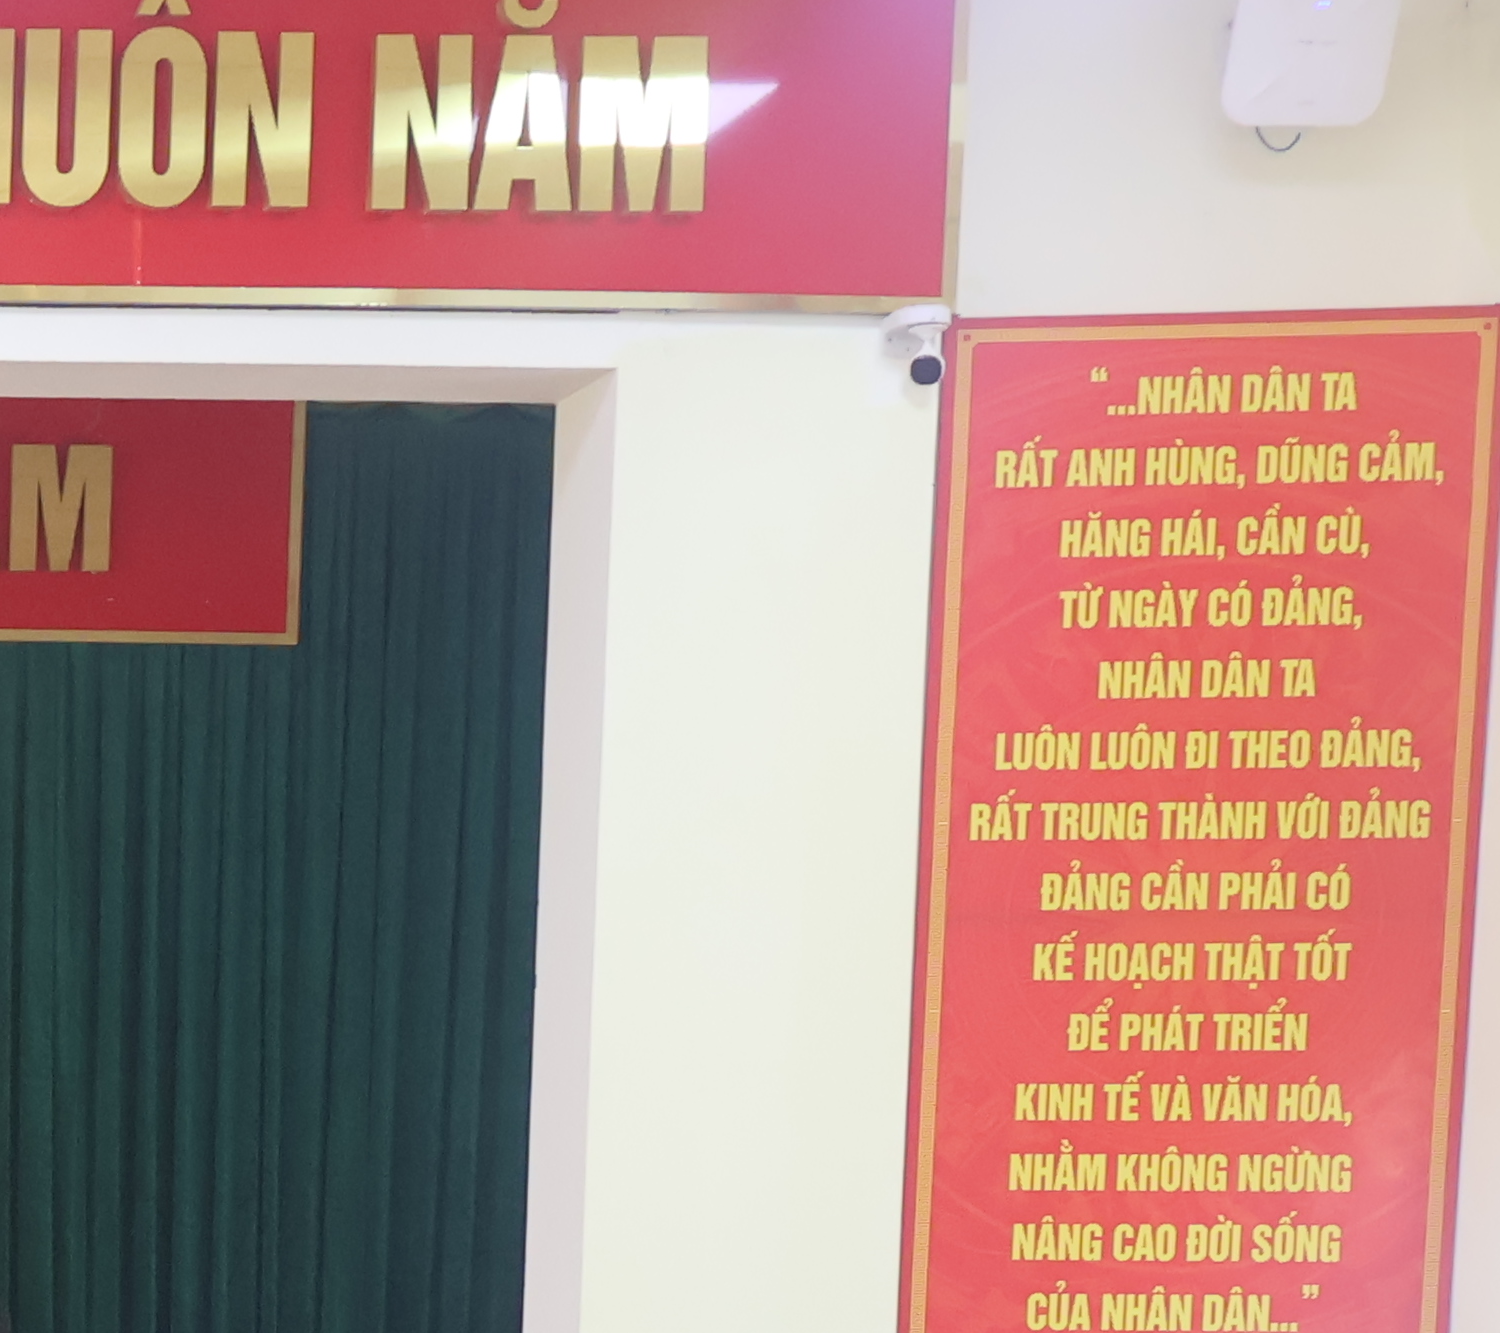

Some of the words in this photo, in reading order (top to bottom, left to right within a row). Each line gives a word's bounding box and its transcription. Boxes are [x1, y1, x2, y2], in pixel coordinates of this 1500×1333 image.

[369, 0, 710, 213] NĂM
[1241, 366, 1310, 412] DÂN
[1321, 372, 1356, 411] TA
[996, 436, 1058, 488] RẤT
[1066, 449, 1135, 486] ANH
[1145, 439, 1245, 488] HÙNG,
[1257, 437, 1348, 484] DŨNG
[1359, 430, 1443, 485] CẢM,
[1060, 512, 1151, 557] HĂNG
[1161, 510, 1225, 560] HÁI,
[1109, 581, 1198, 628] NGÀY
[1208, 580, 1251, 626] CÓ
[1262, 575, 1362, 629] ĐẢNG,
[1098, 653, 1191, 699] NHÂN
[1201, 652, 1270, 698] DÂN
[1280, 659, 1315, 697] TA
[1033, 931, 1077, 980] KẾ
[1085, 943, 1194, 989] HOẠCH
[1205, 935, 1284, 989] THẬT
[1294, 929, 1352, 981] TỐT
[1067, 998, 1113, 1050] ĐỂ
[1120, 1005, 1204, 1051] PHÁT
[1213, 998, 1307, 1051] TRIỂN
[1117, 1146, 1227, 1191] KHÔNG
[1012, 1216, 1102, 1261] NÂNG
[1113, 1224, 1176, 1261] CAO
[1186, 1215, 1241, 1262] ĐỜI
[1252, 1211, 1341, 1262] SỐNG
[1027, 1281, 1090, 1330] CỦA
[1101, 1286, 1192, 1331] NHÂN
